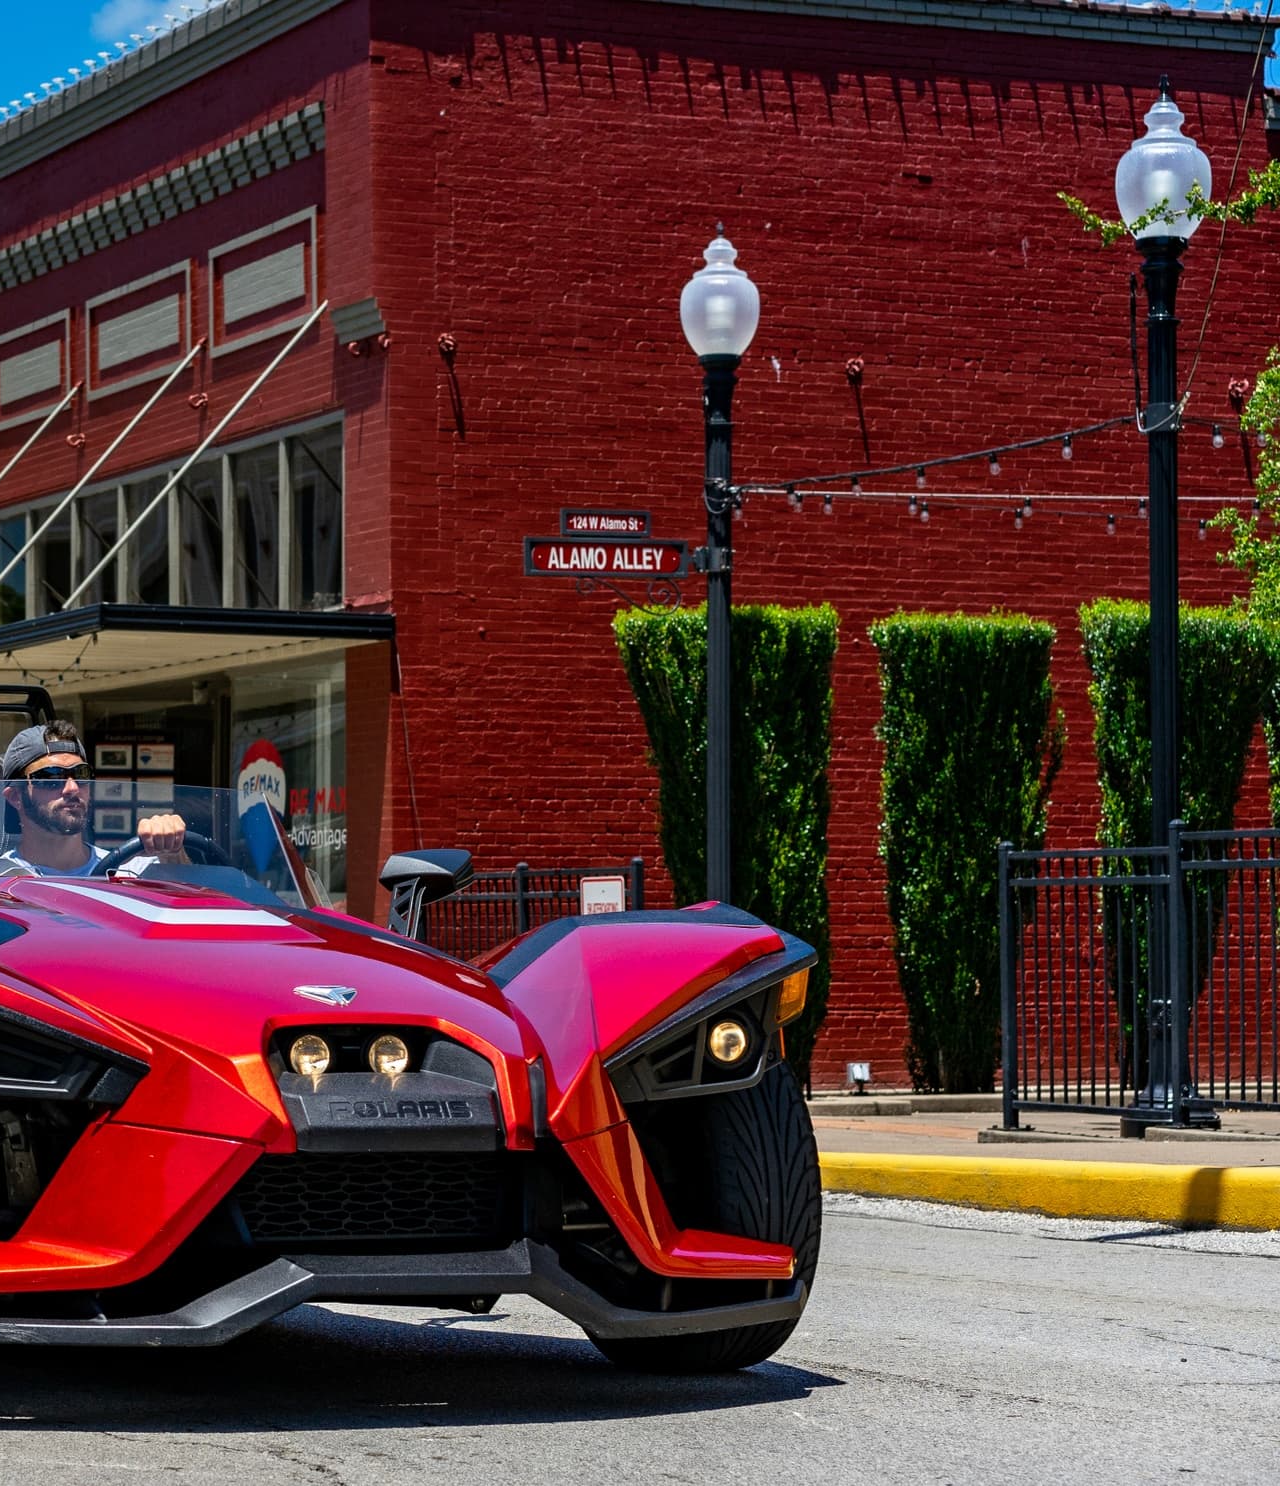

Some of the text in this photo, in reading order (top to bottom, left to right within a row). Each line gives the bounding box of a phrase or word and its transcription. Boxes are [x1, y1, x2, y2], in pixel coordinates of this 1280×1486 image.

[572, 516, 638, 530] 124 W Alamo St
[548, 547, 663, 570] ALAMO ALLEY
[243, 774, 280, 799] RE/MAX
[289, 787, 347, 816] RE/MAX
[291, 826, 347, 850] Advantage
[329, 1100, 473, 1121] POLARIS
